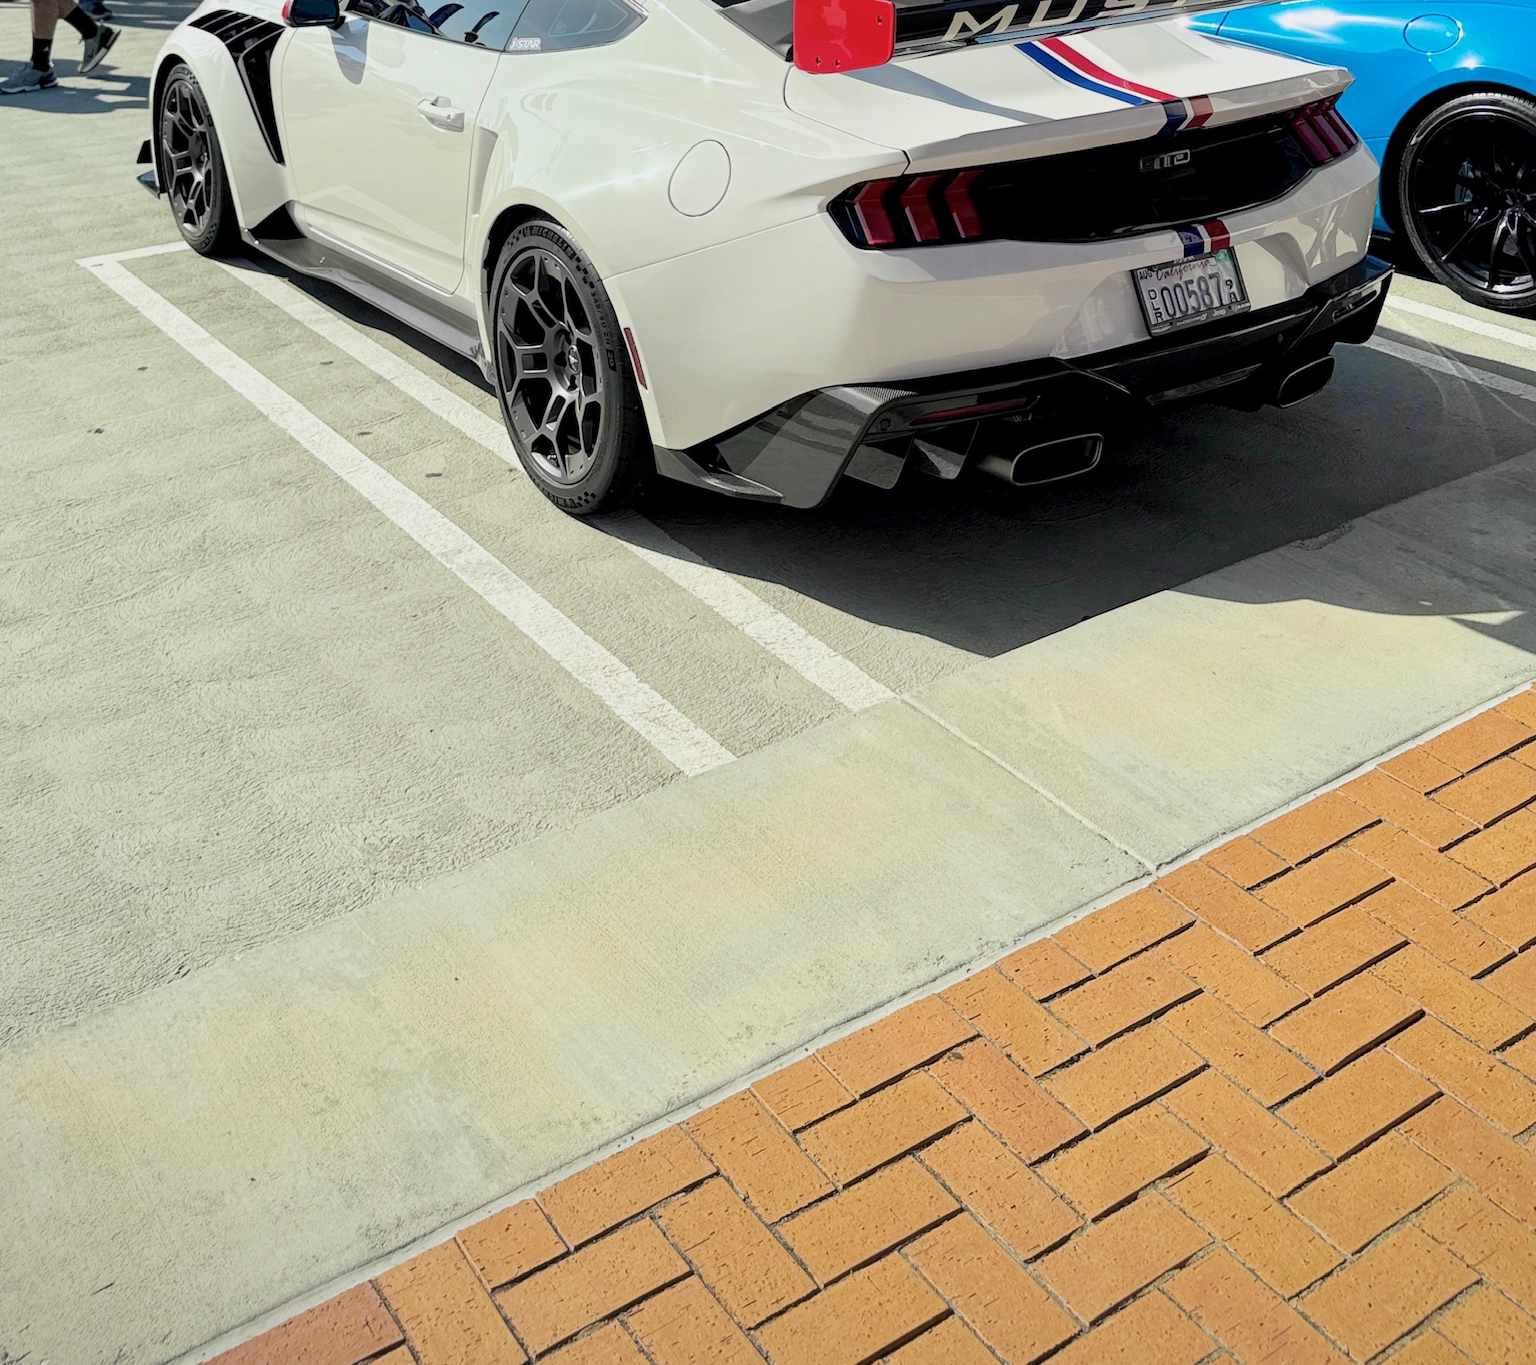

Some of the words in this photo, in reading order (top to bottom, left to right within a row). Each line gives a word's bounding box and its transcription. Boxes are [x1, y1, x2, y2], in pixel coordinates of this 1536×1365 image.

[532, 226, 574, 260] MICHELIN
[1156, 259, 1217, 281] California
[1161, 272, 1223, 319] 00587
[1212, 308, 1227, 317] Jeep
